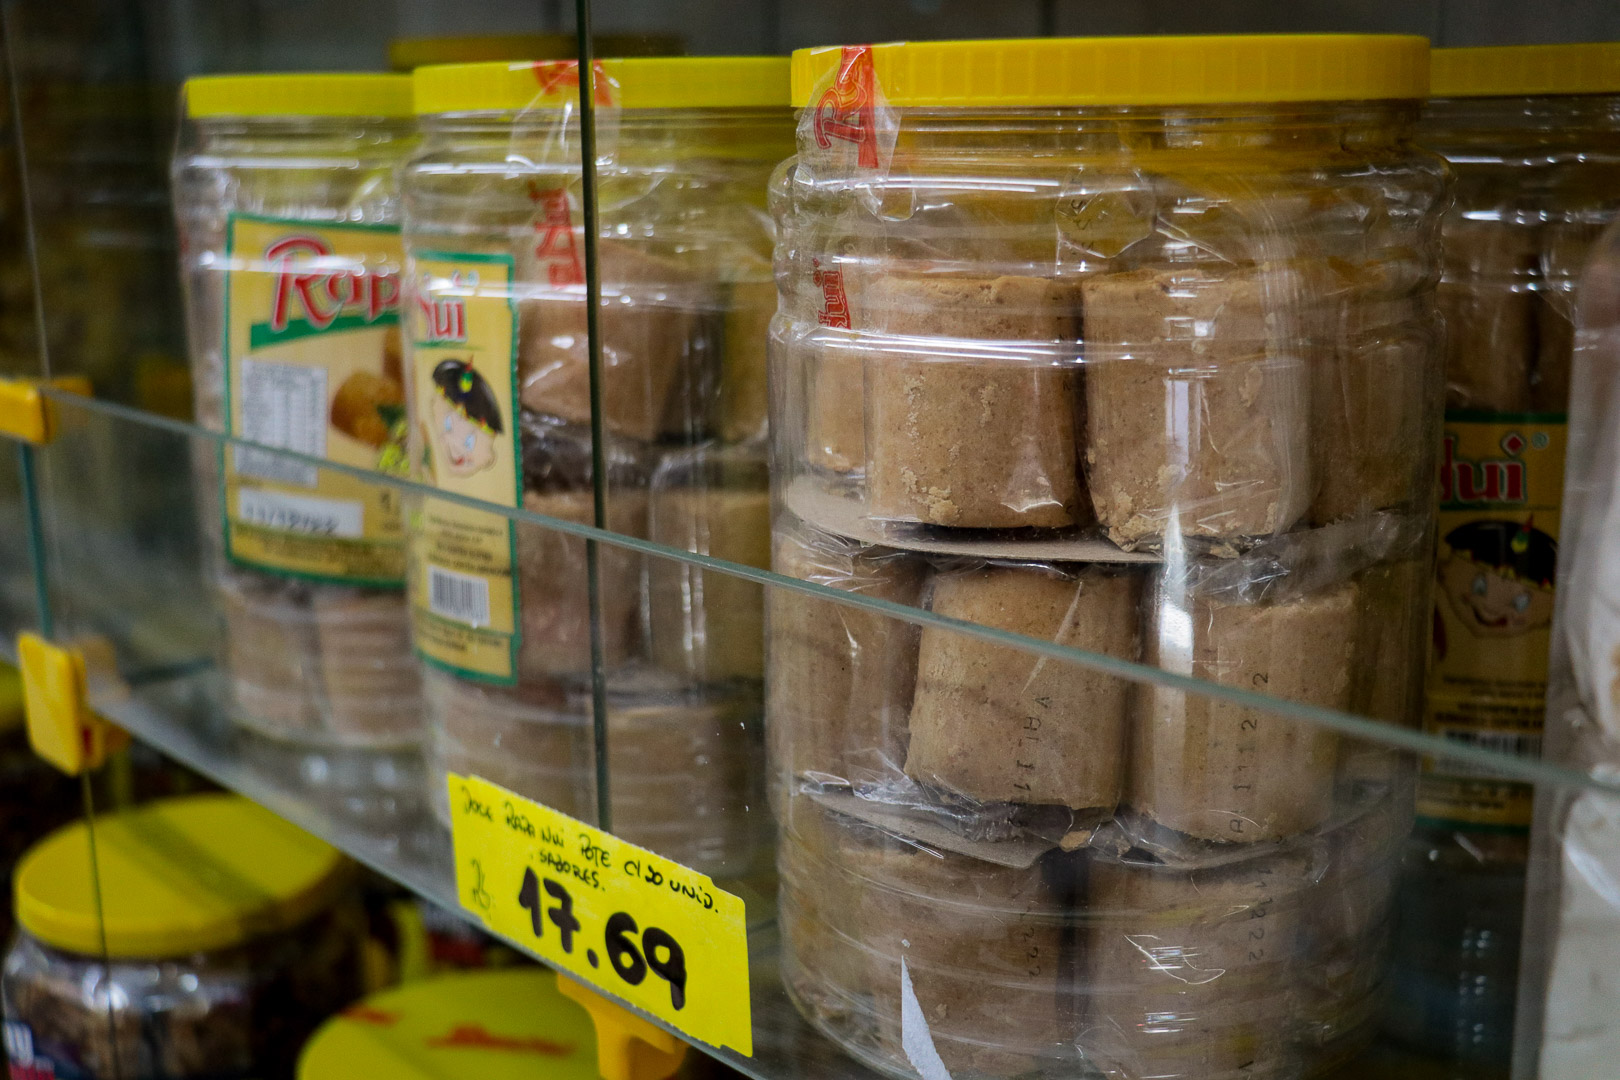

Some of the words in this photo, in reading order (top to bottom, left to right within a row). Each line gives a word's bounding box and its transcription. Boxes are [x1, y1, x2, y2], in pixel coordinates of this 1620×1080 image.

[266, 236, 402, 332] Rap
[578, 833, 612, 868] POTE
[517, 866, 688, 1011] 17.69
